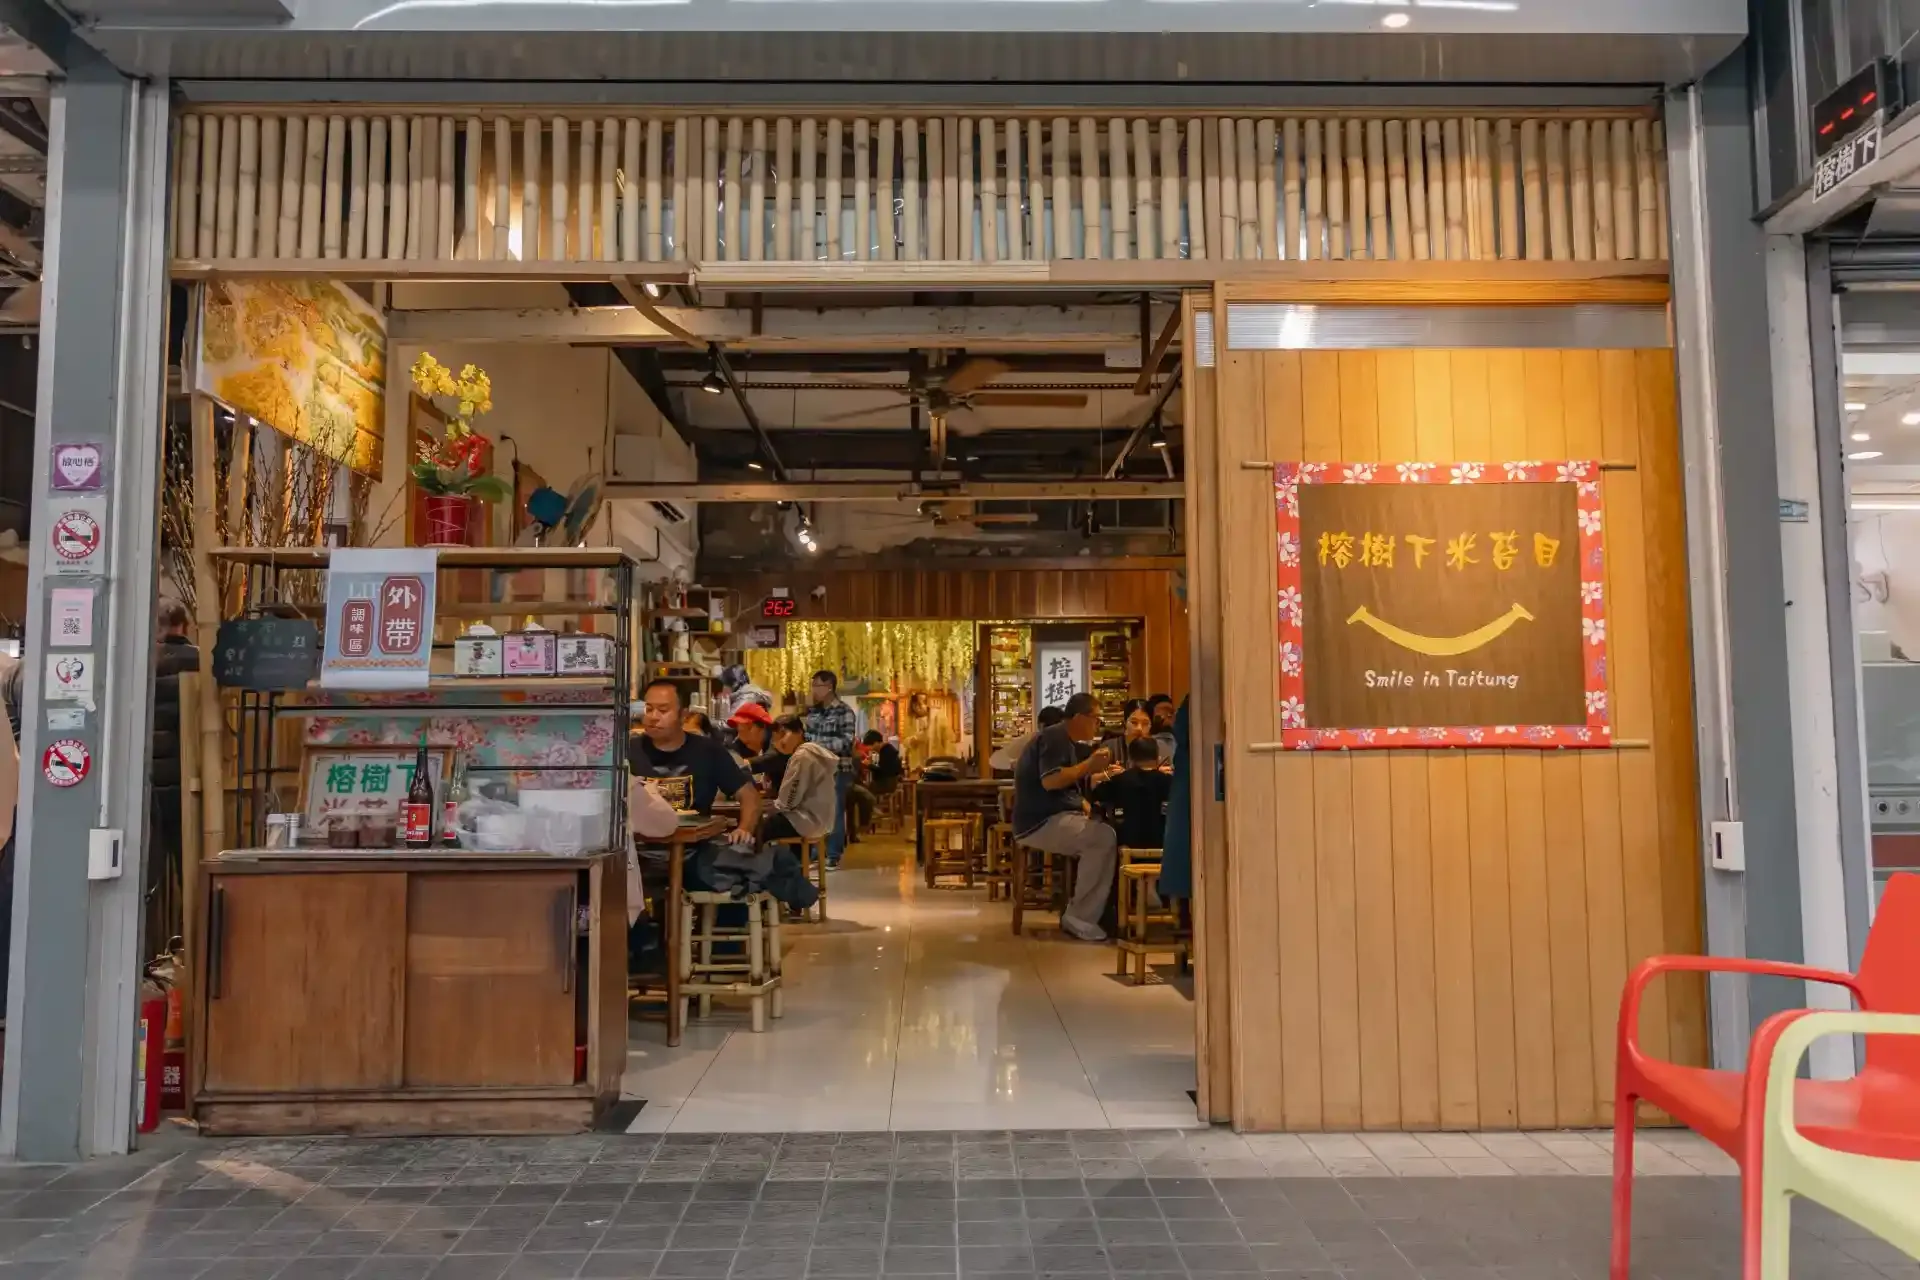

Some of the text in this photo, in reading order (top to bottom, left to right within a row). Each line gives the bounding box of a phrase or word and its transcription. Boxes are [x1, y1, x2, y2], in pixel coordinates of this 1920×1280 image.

[1817, 127, 1878, 194] 榕樹下
[1317, 529, 1561, 571] 榕樹下米苔目
[348, 607, 366, 652] 調味區
[385, 585, 417, 649] 外帶
[764, 600, 795, 616] 262
[1044, 656, 1077, 710] 榕樹
[1364, 669, 1520, 689] Smile in Taitung
